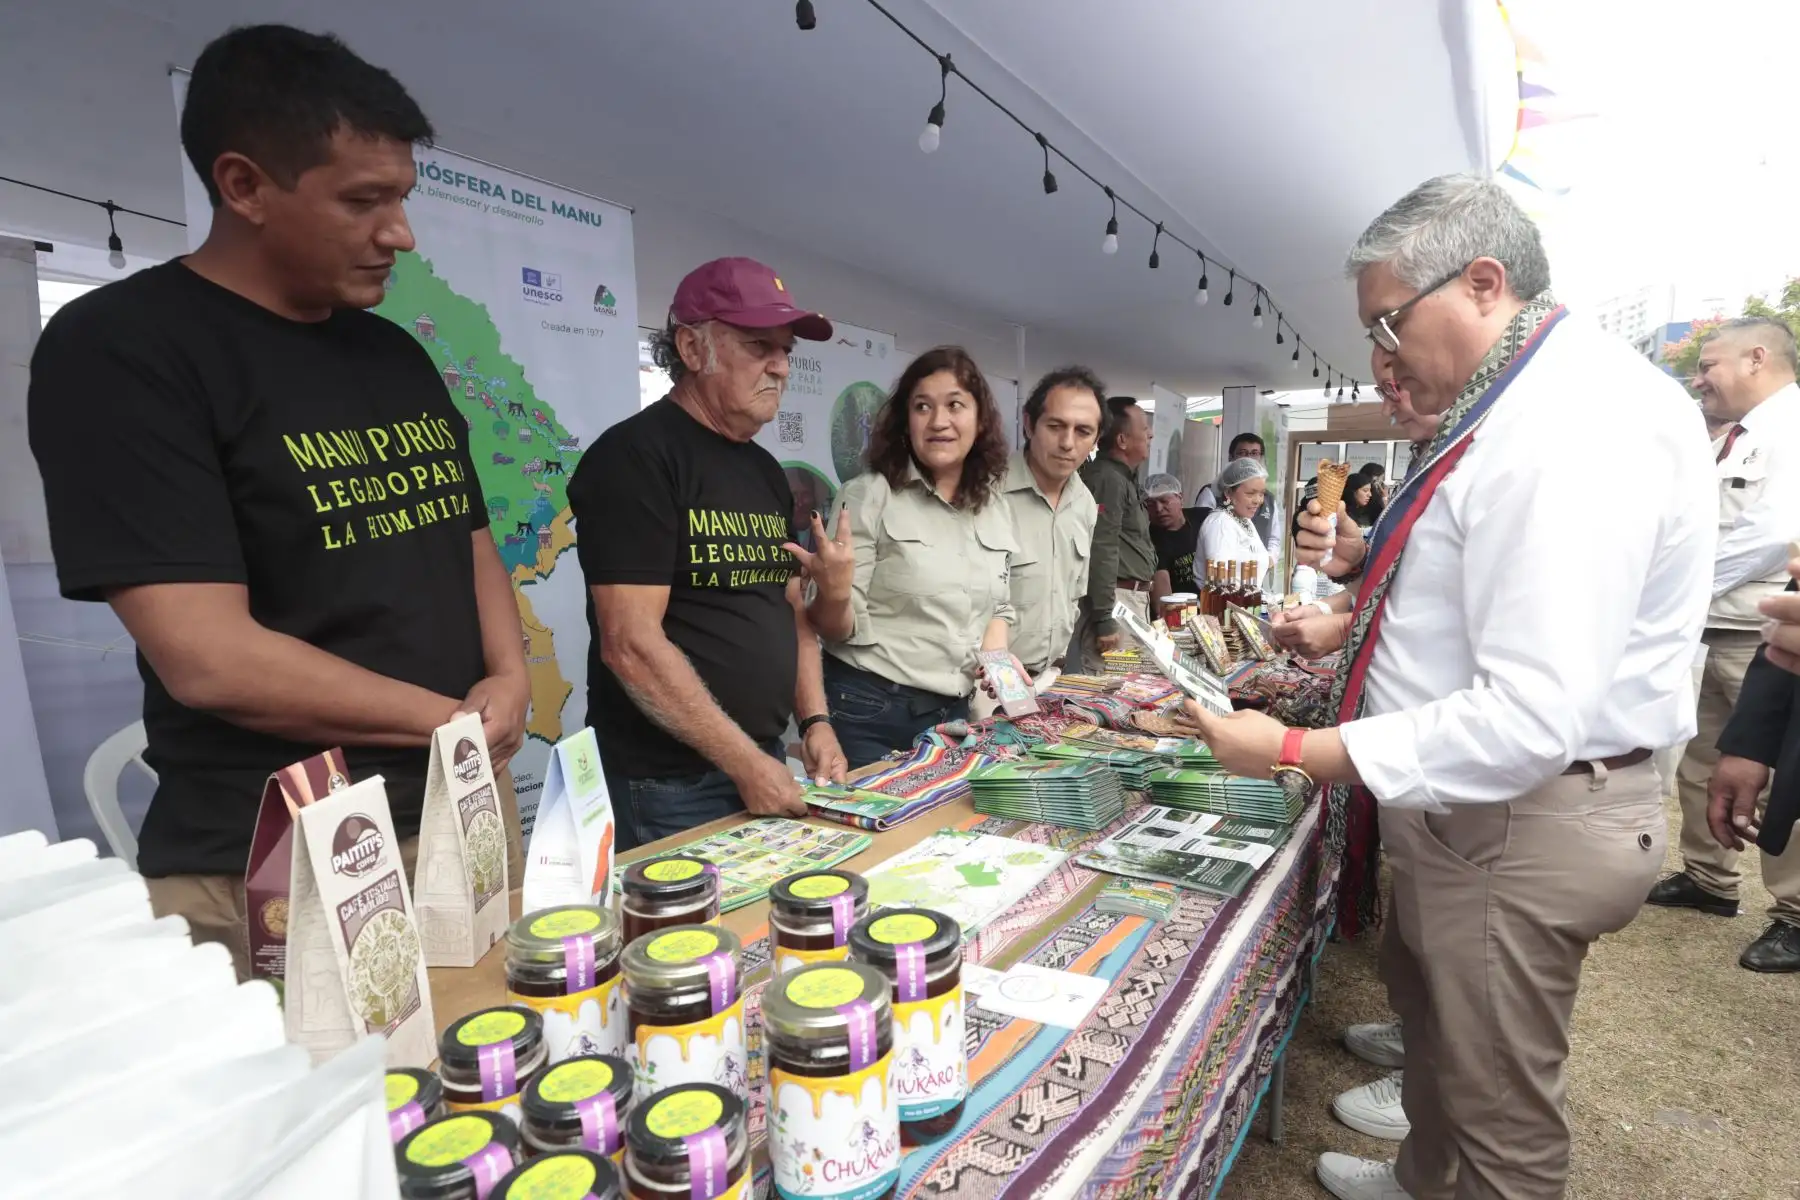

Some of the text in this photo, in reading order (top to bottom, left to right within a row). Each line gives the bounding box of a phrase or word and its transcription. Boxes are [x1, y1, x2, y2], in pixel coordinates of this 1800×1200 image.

[415, 161, 506, 200] IÓSFERA
[511, 189, 547, 212] DEL
[551, 200, 602, 227] MANU
[427, 187, 481, 209] bienestar
[482, 203, 491, 213] y
[492, 206, 544, 226] desarrollo
[522, 286, 563, 302] unesco
[593, 305, 617, 316] MANU
[541, 320, 604, 338] Creada en 1977
[787, 355, 822, 373] PURÚS
[282, 411, 457, 472] MANU PURÚS
[307, 471, 409, 513] LEGADO
[321, 521, 357, 550] LA
[688, 508, 748, 537] MANU
[689, 543, 766, 564] LEGADO
[691, 572, 719, 587] LA
[331, 831, 385, 875] PAITITI'S
